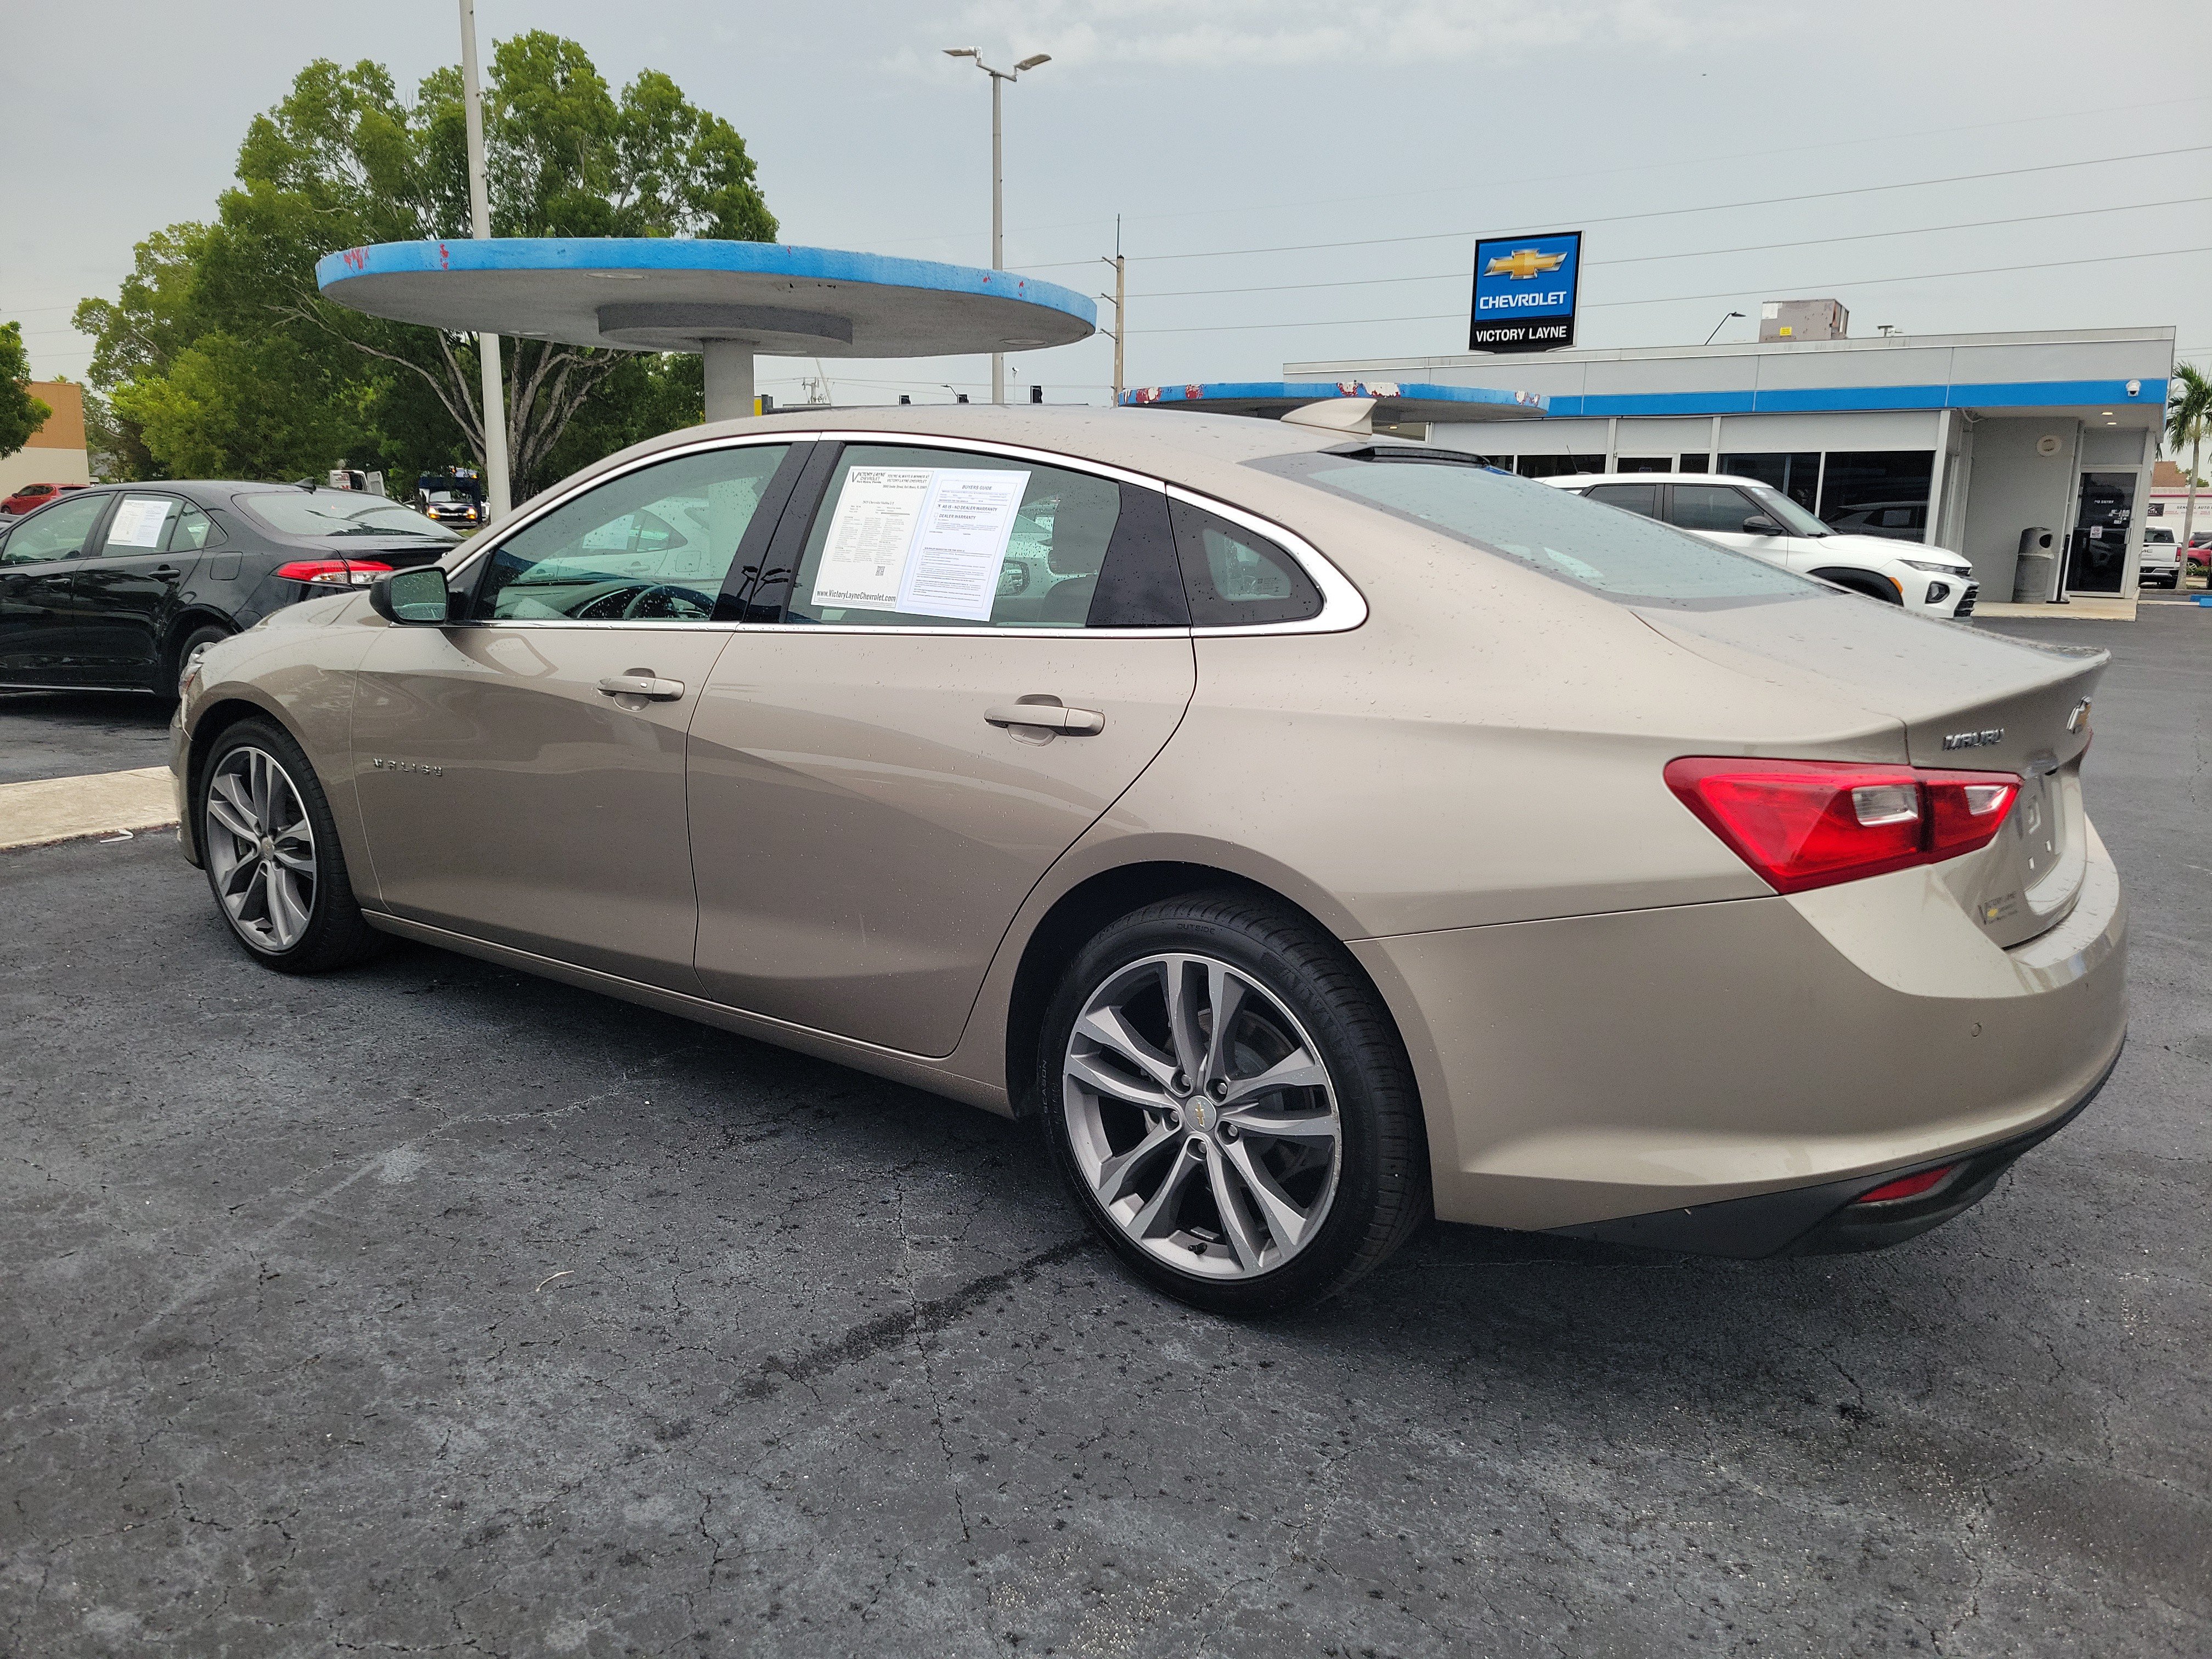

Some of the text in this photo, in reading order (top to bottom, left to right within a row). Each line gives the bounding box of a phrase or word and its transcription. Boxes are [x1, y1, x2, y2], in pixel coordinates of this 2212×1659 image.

[1480, 291, 1567, 309] CHEVROLET
[1476, 326, 1567, 342] VICTORY LAYNE
[817, 589, 896, 602] www.VictoryLayneChevrolet.com
[1177, 923, 1215, 934] OUTSIDE
